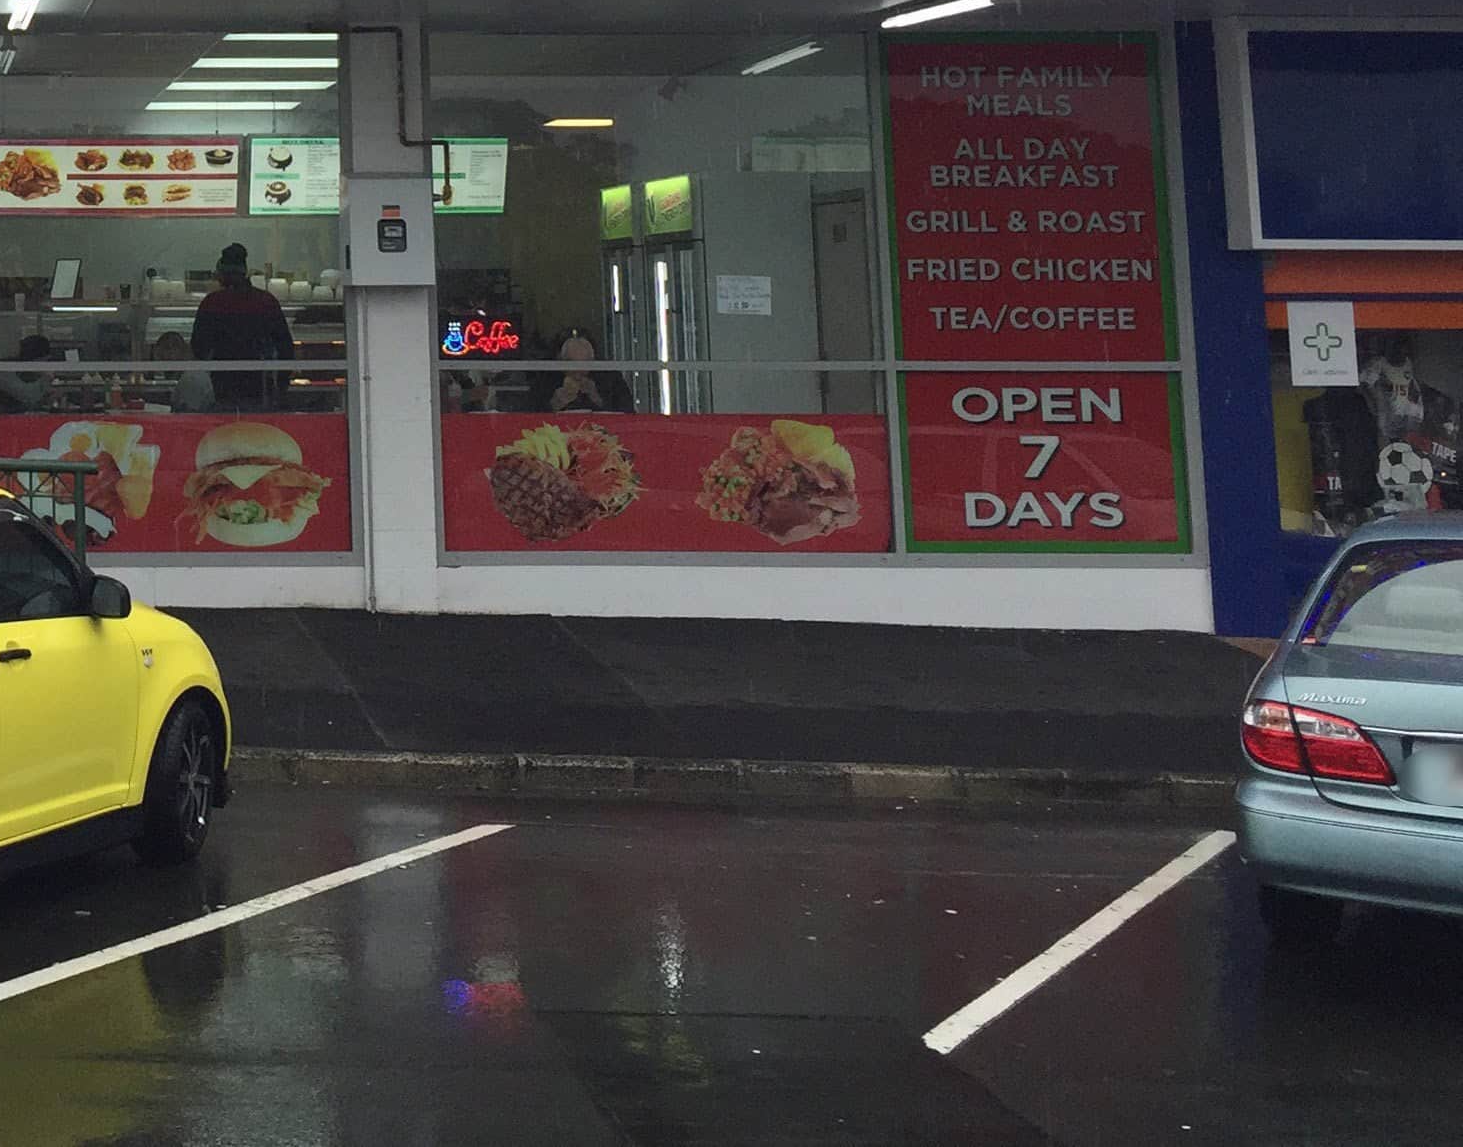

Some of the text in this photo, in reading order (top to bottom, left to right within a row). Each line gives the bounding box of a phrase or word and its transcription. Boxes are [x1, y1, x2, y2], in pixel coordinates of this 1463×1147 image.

[920, 66, 1113, 88] HOT FAMILY
[966, 93, 1073, 117] MEALS
[953, 137, 1090, 161] ALL DAY
[929, 164, 1120, 188] BREAKFAST
[905, 209, 1146, 234] GRILL & ROAST
[906, 257, 1154, 282] FRIED CHICKEN
[928, 303, 1137, 333] TEA/COFFEE
[464, 321, 519, 352] Coffee
[951, 386, 1123, 423] OPEN
[1018, 434, 1061, 479] 7
[963, 490, 1125, 528] DAYS
[1297, 692, 1367, 706] Maxima
